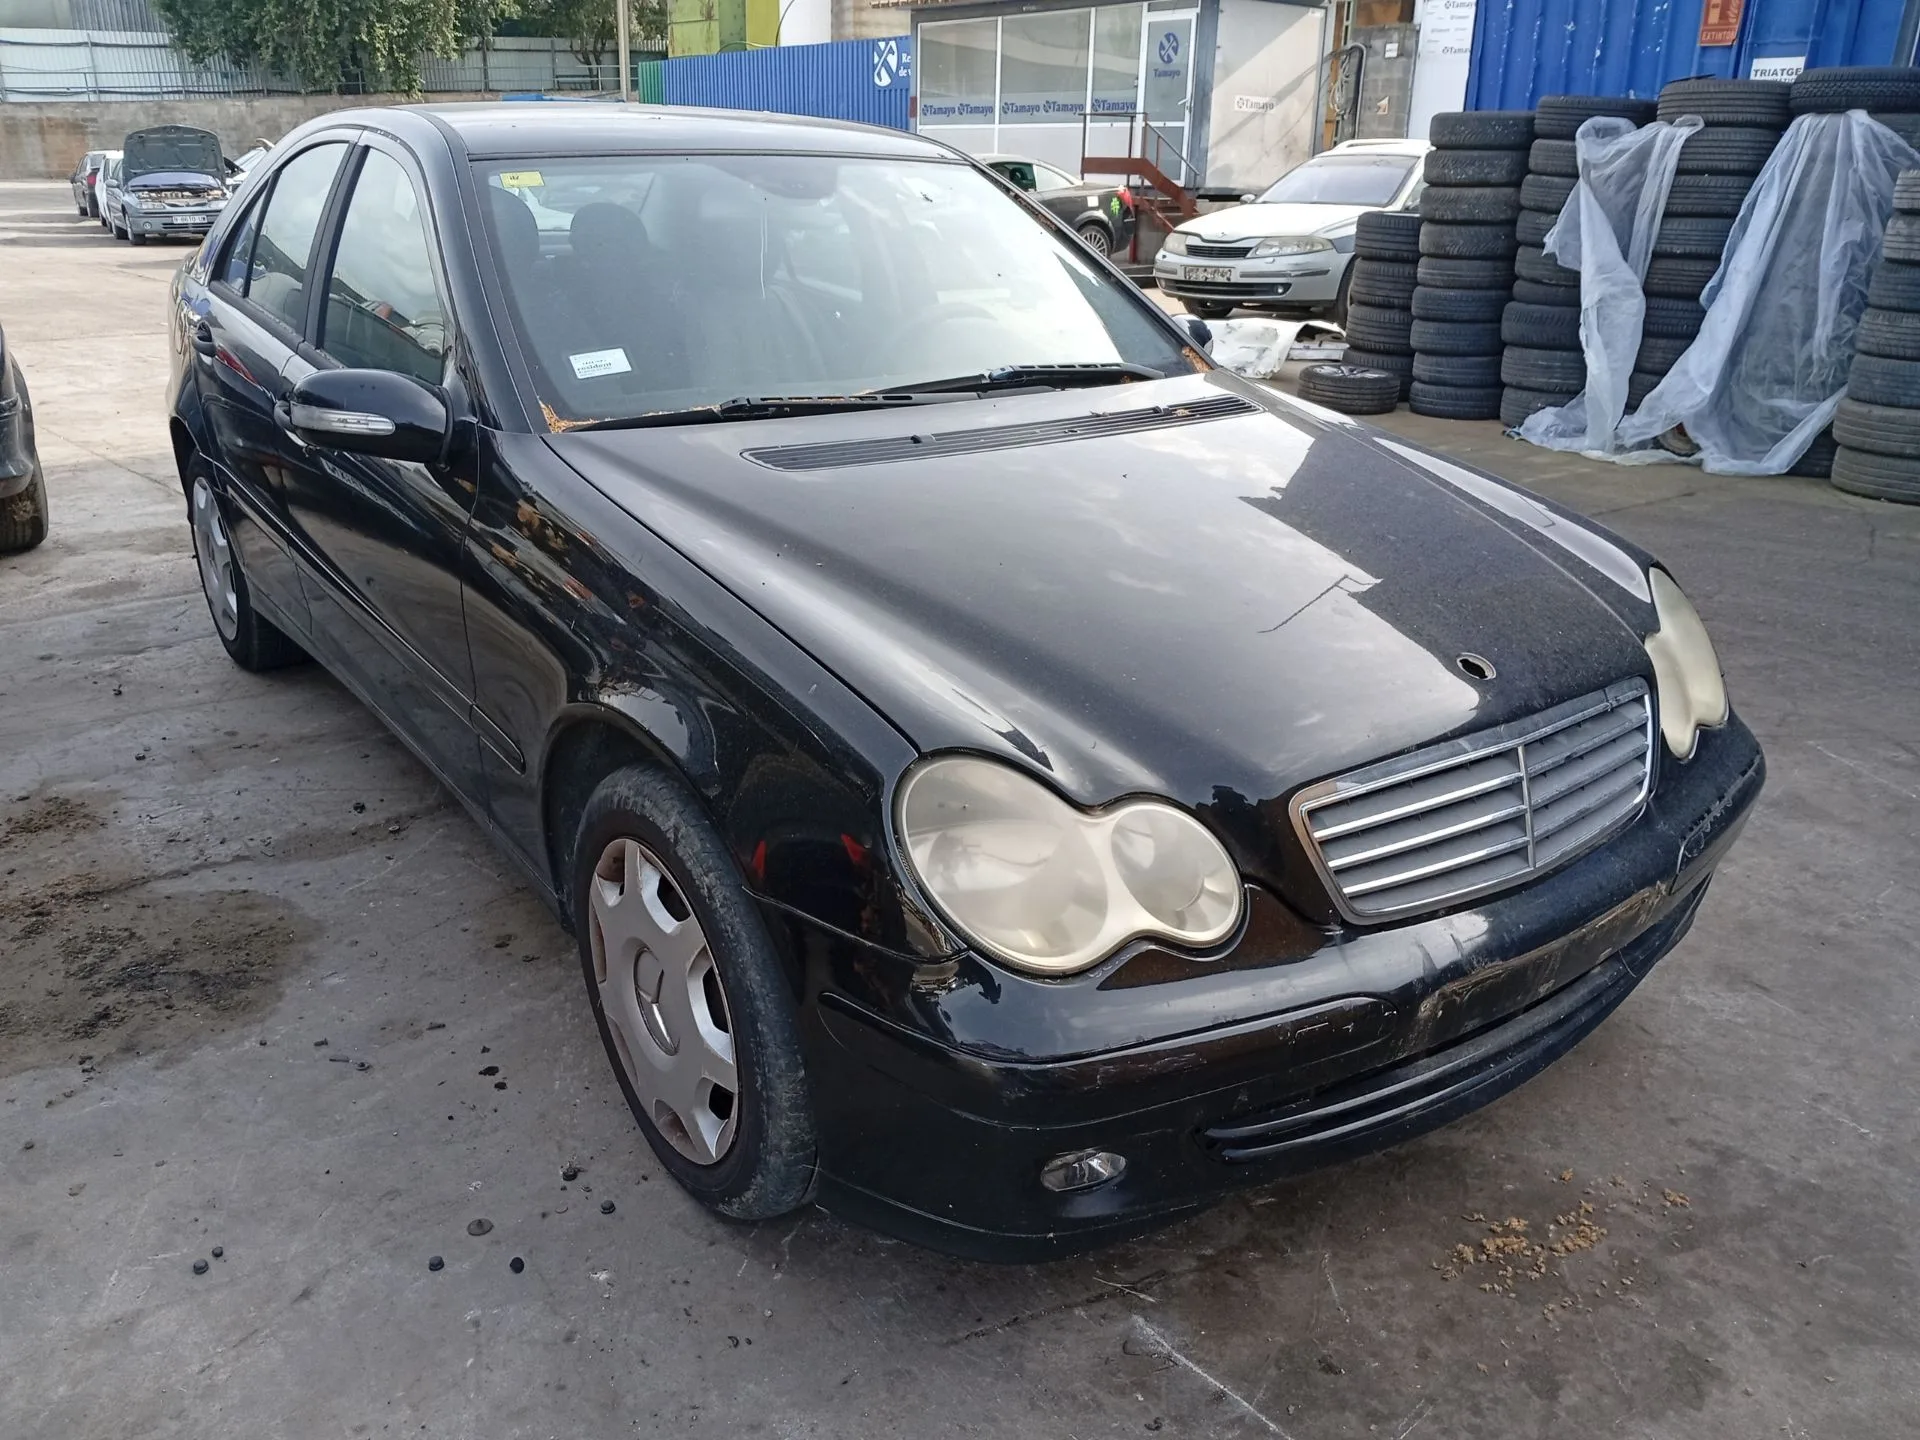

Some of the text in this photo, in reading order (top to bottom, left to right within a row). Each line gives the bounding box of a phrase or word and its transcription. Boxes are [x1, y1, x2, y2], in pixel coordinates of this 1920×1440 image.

[1153, 68, 1181, 80] Tamayo
[1753, 67, 1802, 77] TRIATGE
[928, 104, 956, 117] Tamayo
[964, 103, 993, 117] Tamayo
[1009, 102, 1040, 116] Tamayo
[1051, 101, 1084, 115] Tamayo
[1101, 99, 1137, 113] Tamayo
[1245, 98, 1274, 112] Tamayo
